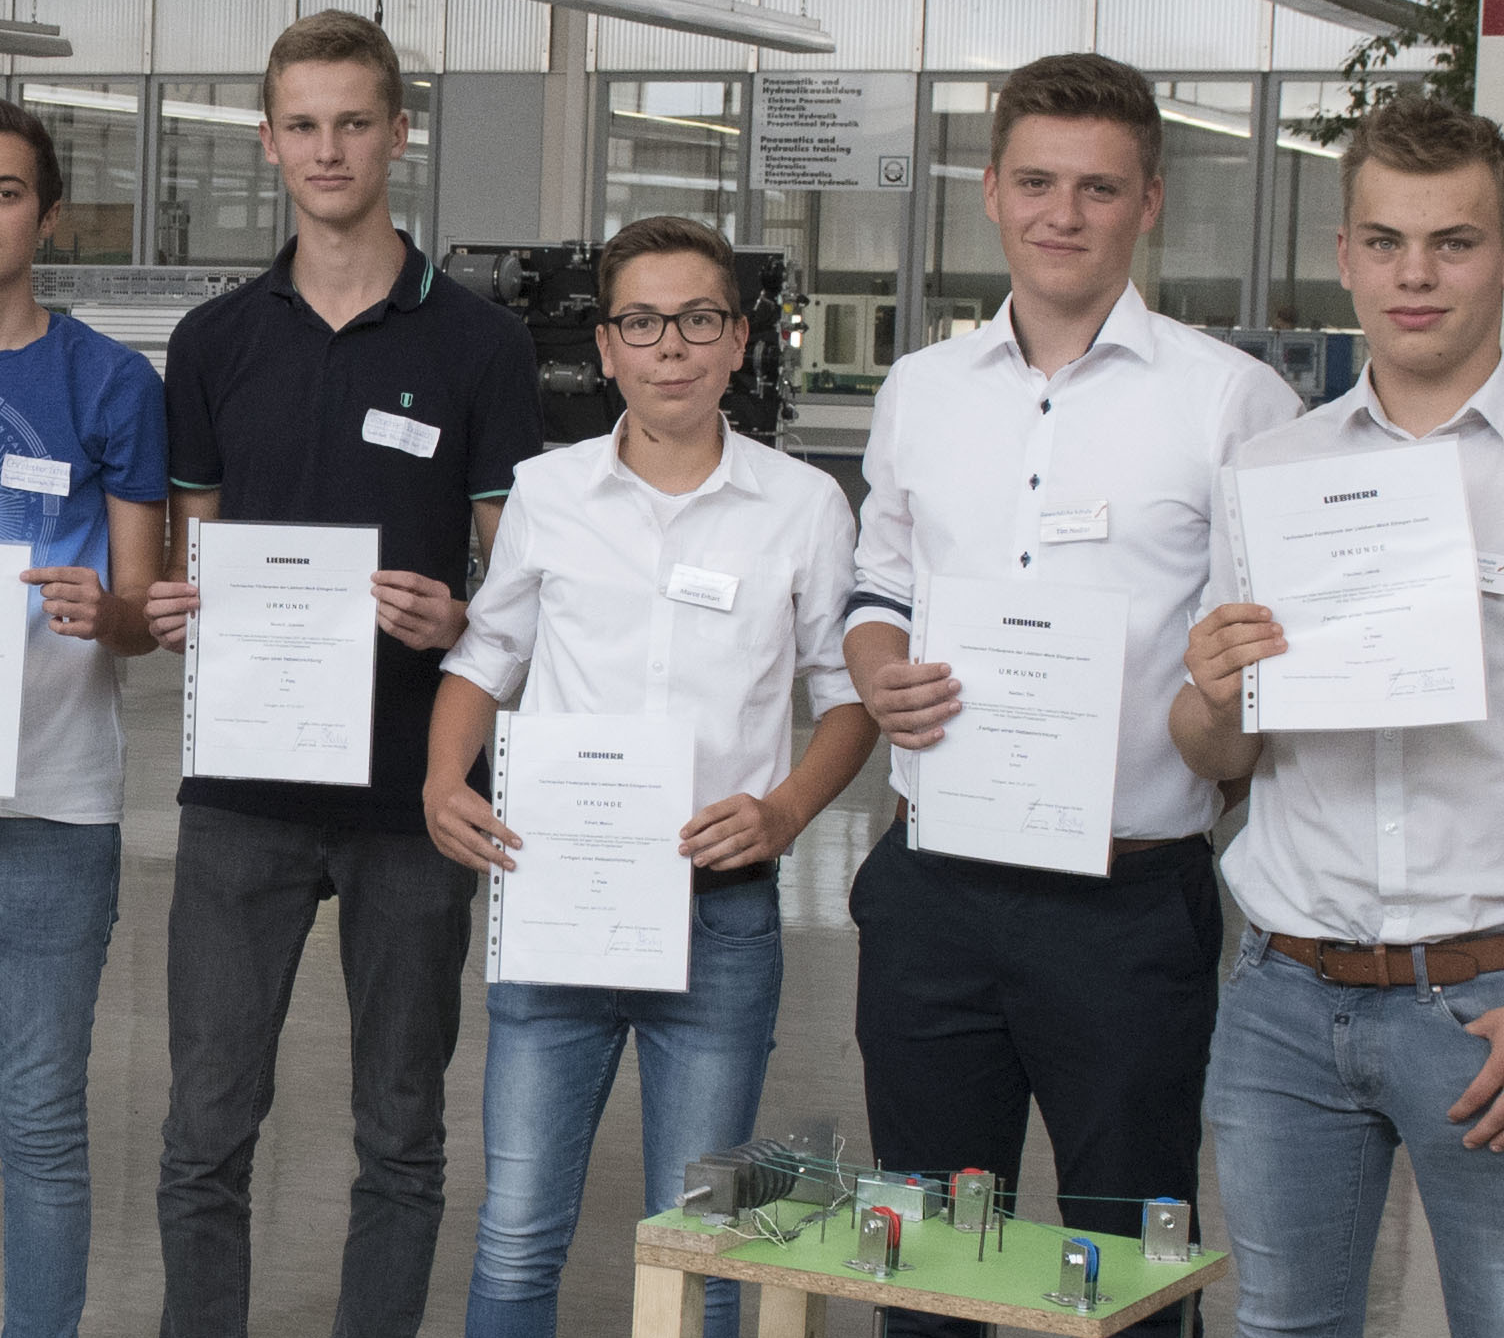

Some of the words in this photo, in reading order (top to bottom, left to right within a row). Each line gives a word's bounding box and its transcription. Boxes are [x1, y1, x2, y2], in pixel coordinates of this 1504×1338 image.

[1324, 489, 1379, 505] LIEBHERR
[1330, 543, 1387, 559] URKUNDE
[266, 557, 311, 565] LIEBHERR
[266, 602, 310, 611] URKUNDE
[1002, 616, 1052, 629] LIEBHERR
[998, 667, 1048, 680] URKUNDE
[578, 750, 624, 761] LIEBHERR
[576, 799, 623, 809] URKUNDE
